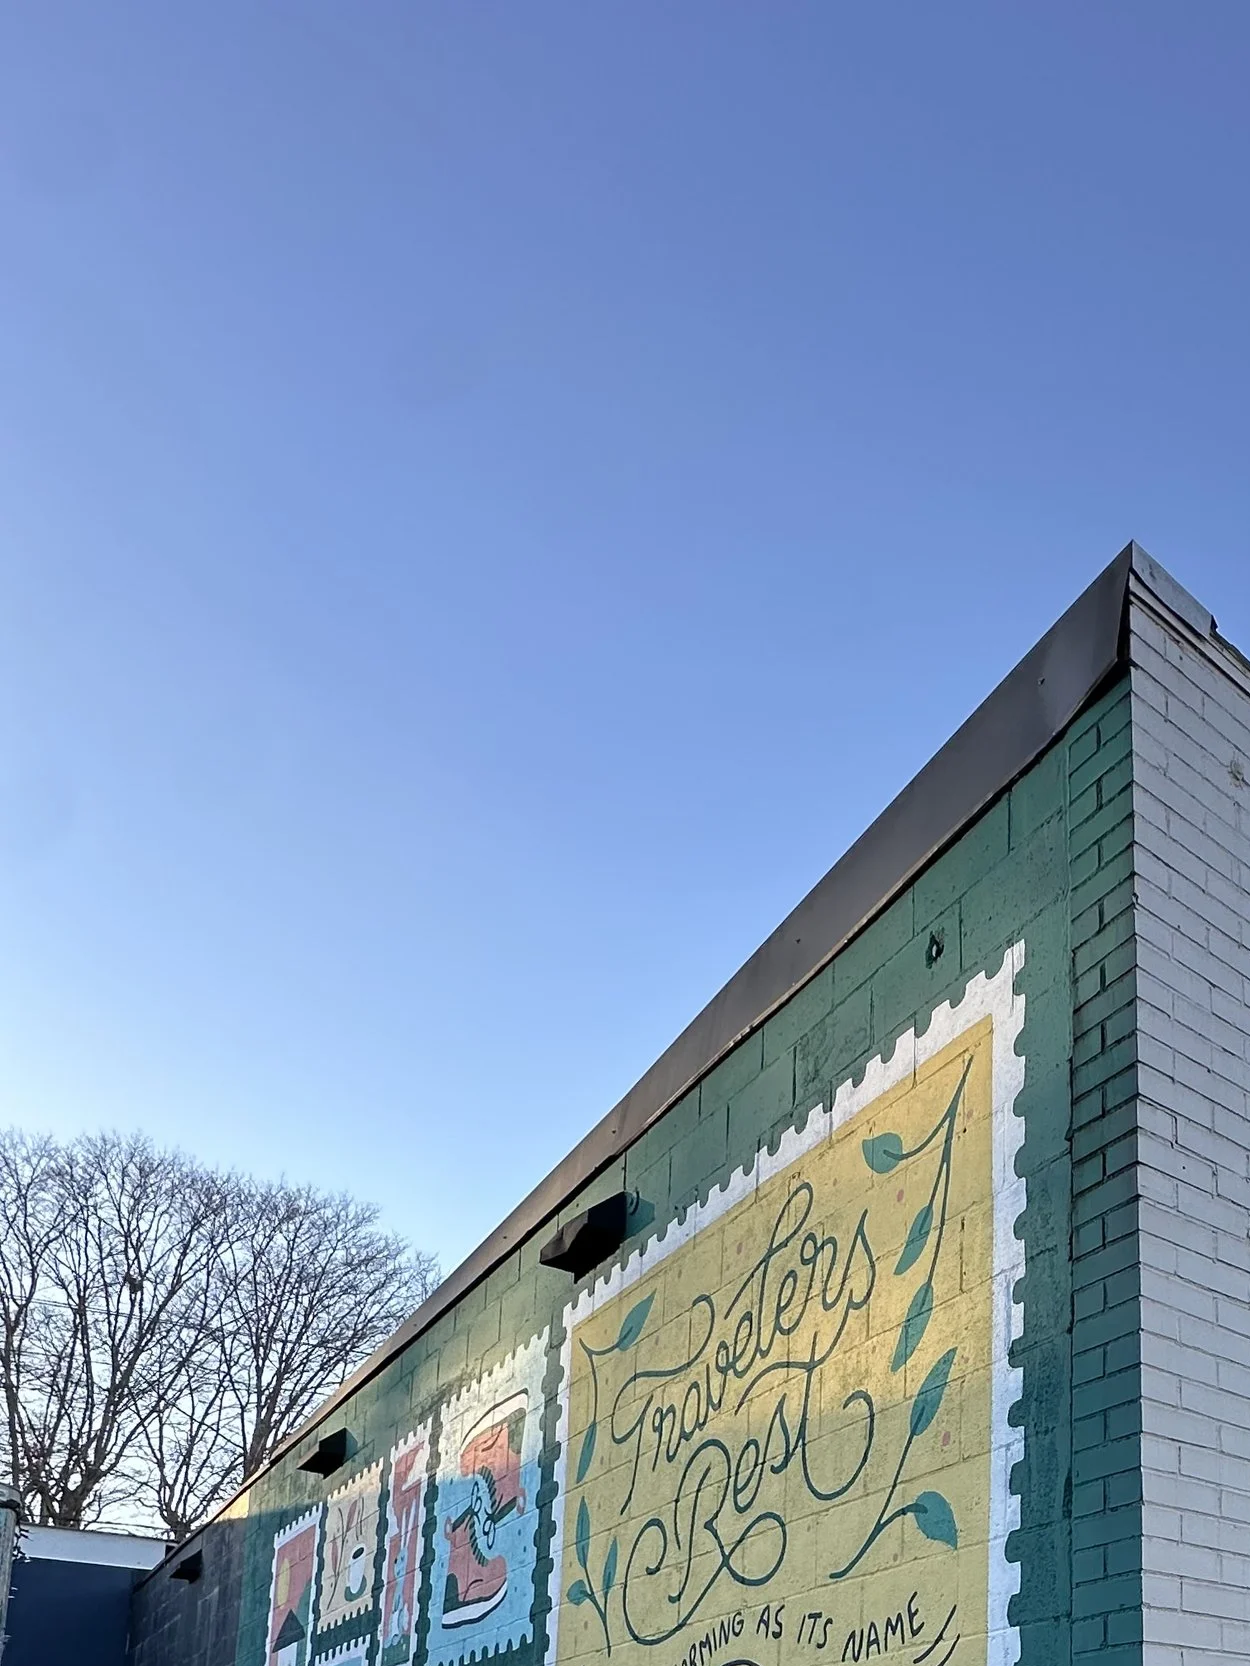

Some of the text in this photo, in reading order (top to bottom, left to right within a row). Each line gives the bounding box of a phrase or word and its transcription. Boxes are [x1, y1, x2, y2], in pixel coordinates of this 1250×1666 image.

[611, 1182, 876, 1515] Travelers
[623, 1331, 875, 1646] Rest
[756, 1604, 785, 1639] AS
[797, 1612, 833, 1649] ITS
[841, 1591, 925, 1663] NAME
